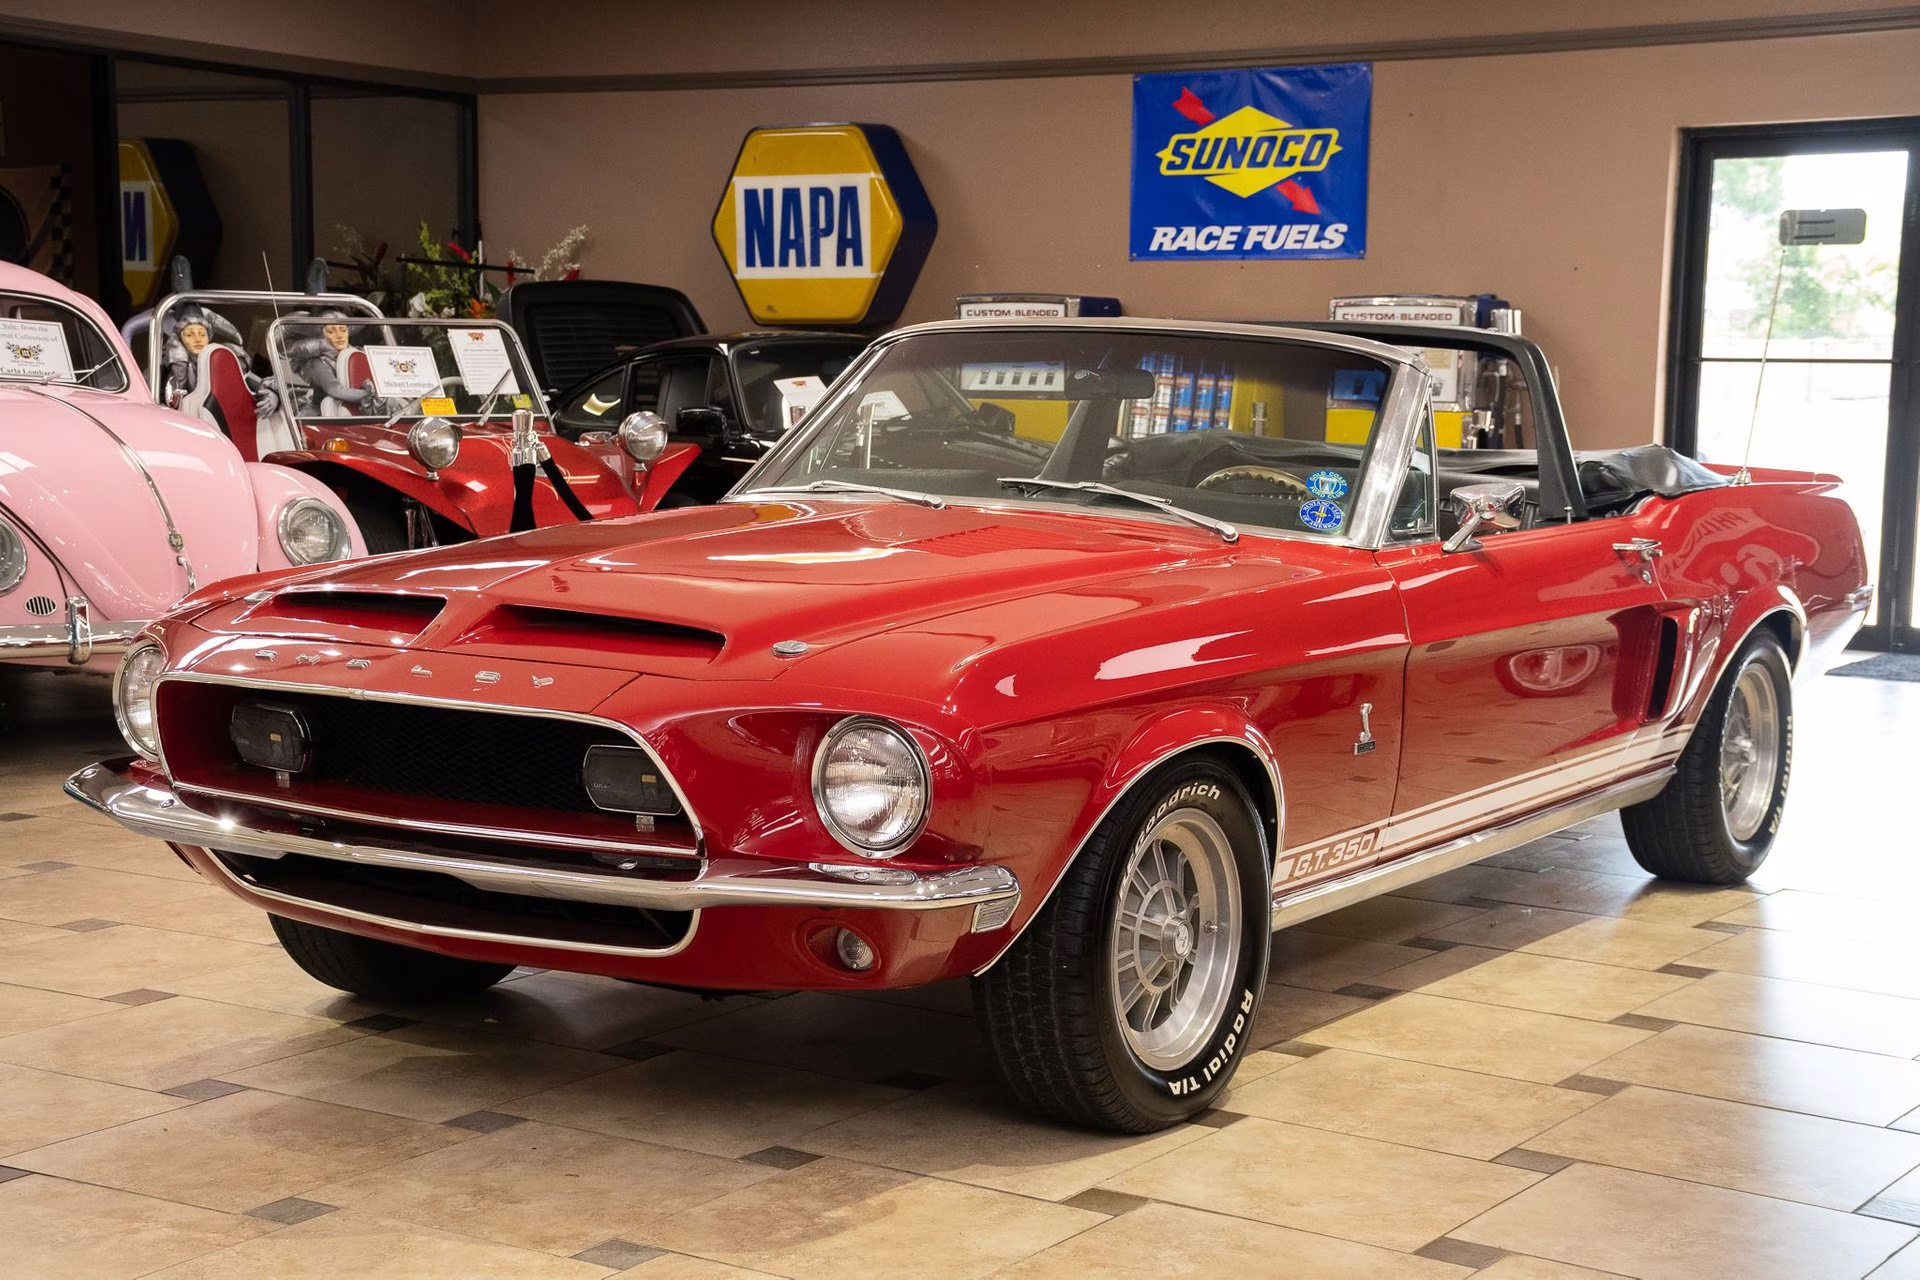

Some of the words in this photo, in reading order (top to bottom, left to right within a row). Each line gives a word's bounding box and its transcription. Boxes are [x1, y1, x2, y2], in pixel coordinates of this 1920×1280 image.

[1165, 133, 1334, 171] SUNOCO
[743, 185, 864, 268] NAPA
[1149, 224, 1243, 252] RACE
[1243, 223, 1349, 251] FUELS
[254, 649, 555, 689] SHELBY
[1203, 988, 1254, 1082] Radial
[1168, 1076, 1201, 1096] T/A
